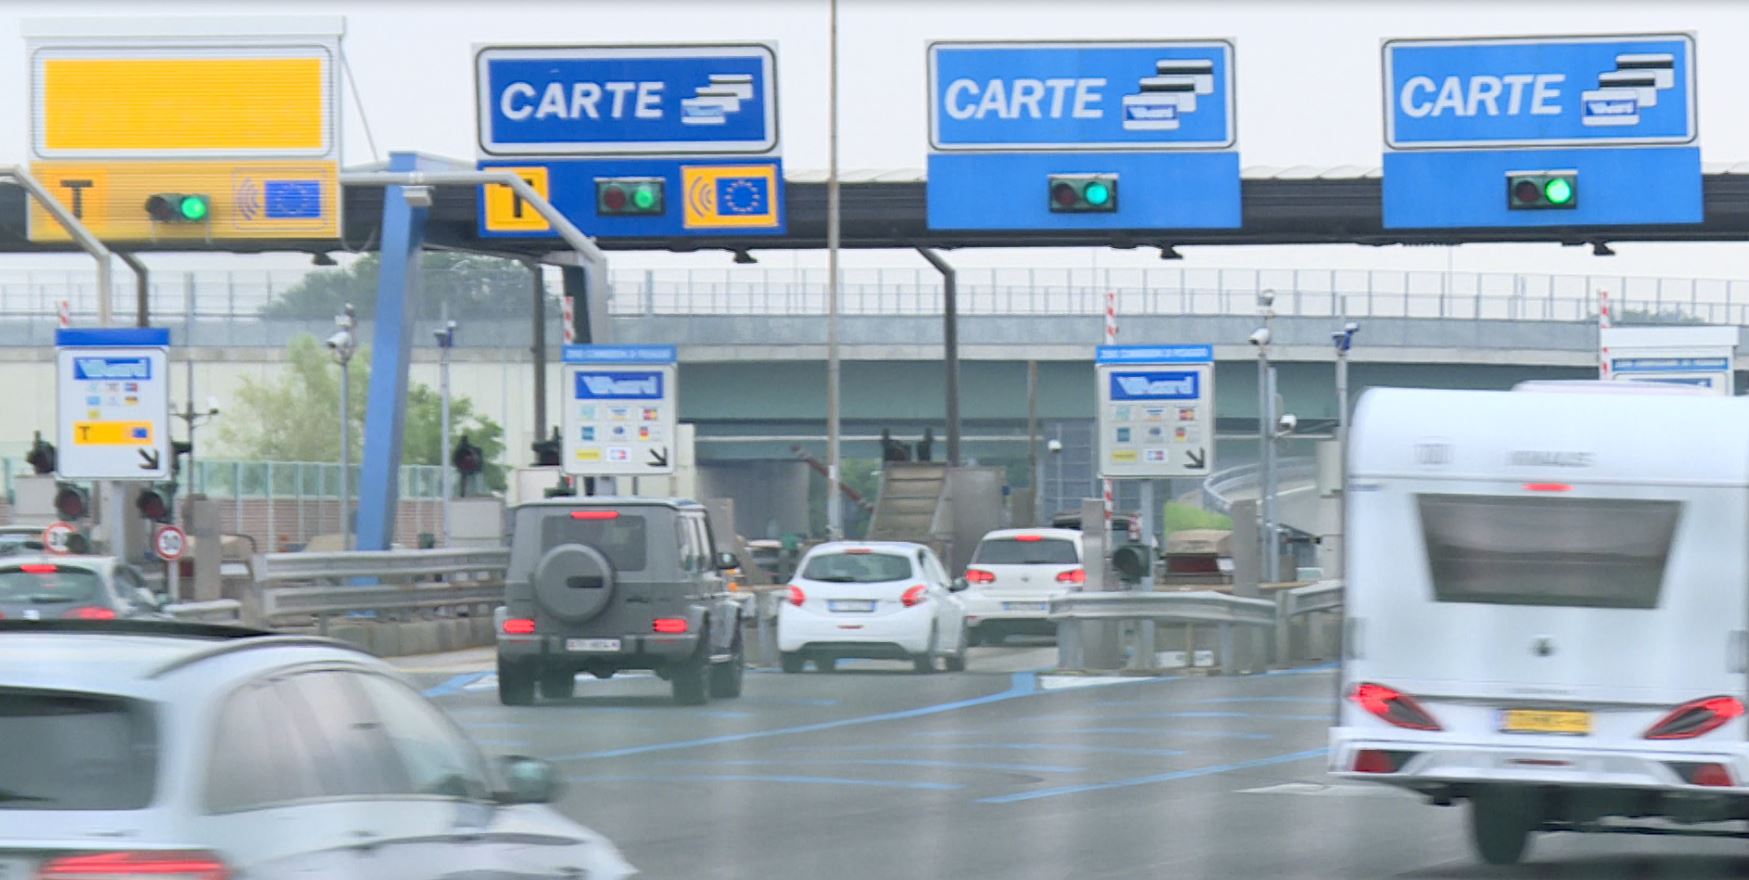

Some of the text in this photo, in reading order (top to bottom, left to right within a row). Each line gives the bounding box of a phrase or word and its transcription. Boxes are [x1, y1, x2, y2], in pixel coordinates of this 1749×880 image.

[501, 82, 665, 120] CARTE
[944, 78, 1107, 120] CARTE
[1400, 74, 1566, 117] CARTE
[60, 179, 93, 219] T
[500, 179, 533, 218] T
[78, 426, 90, 440] T
